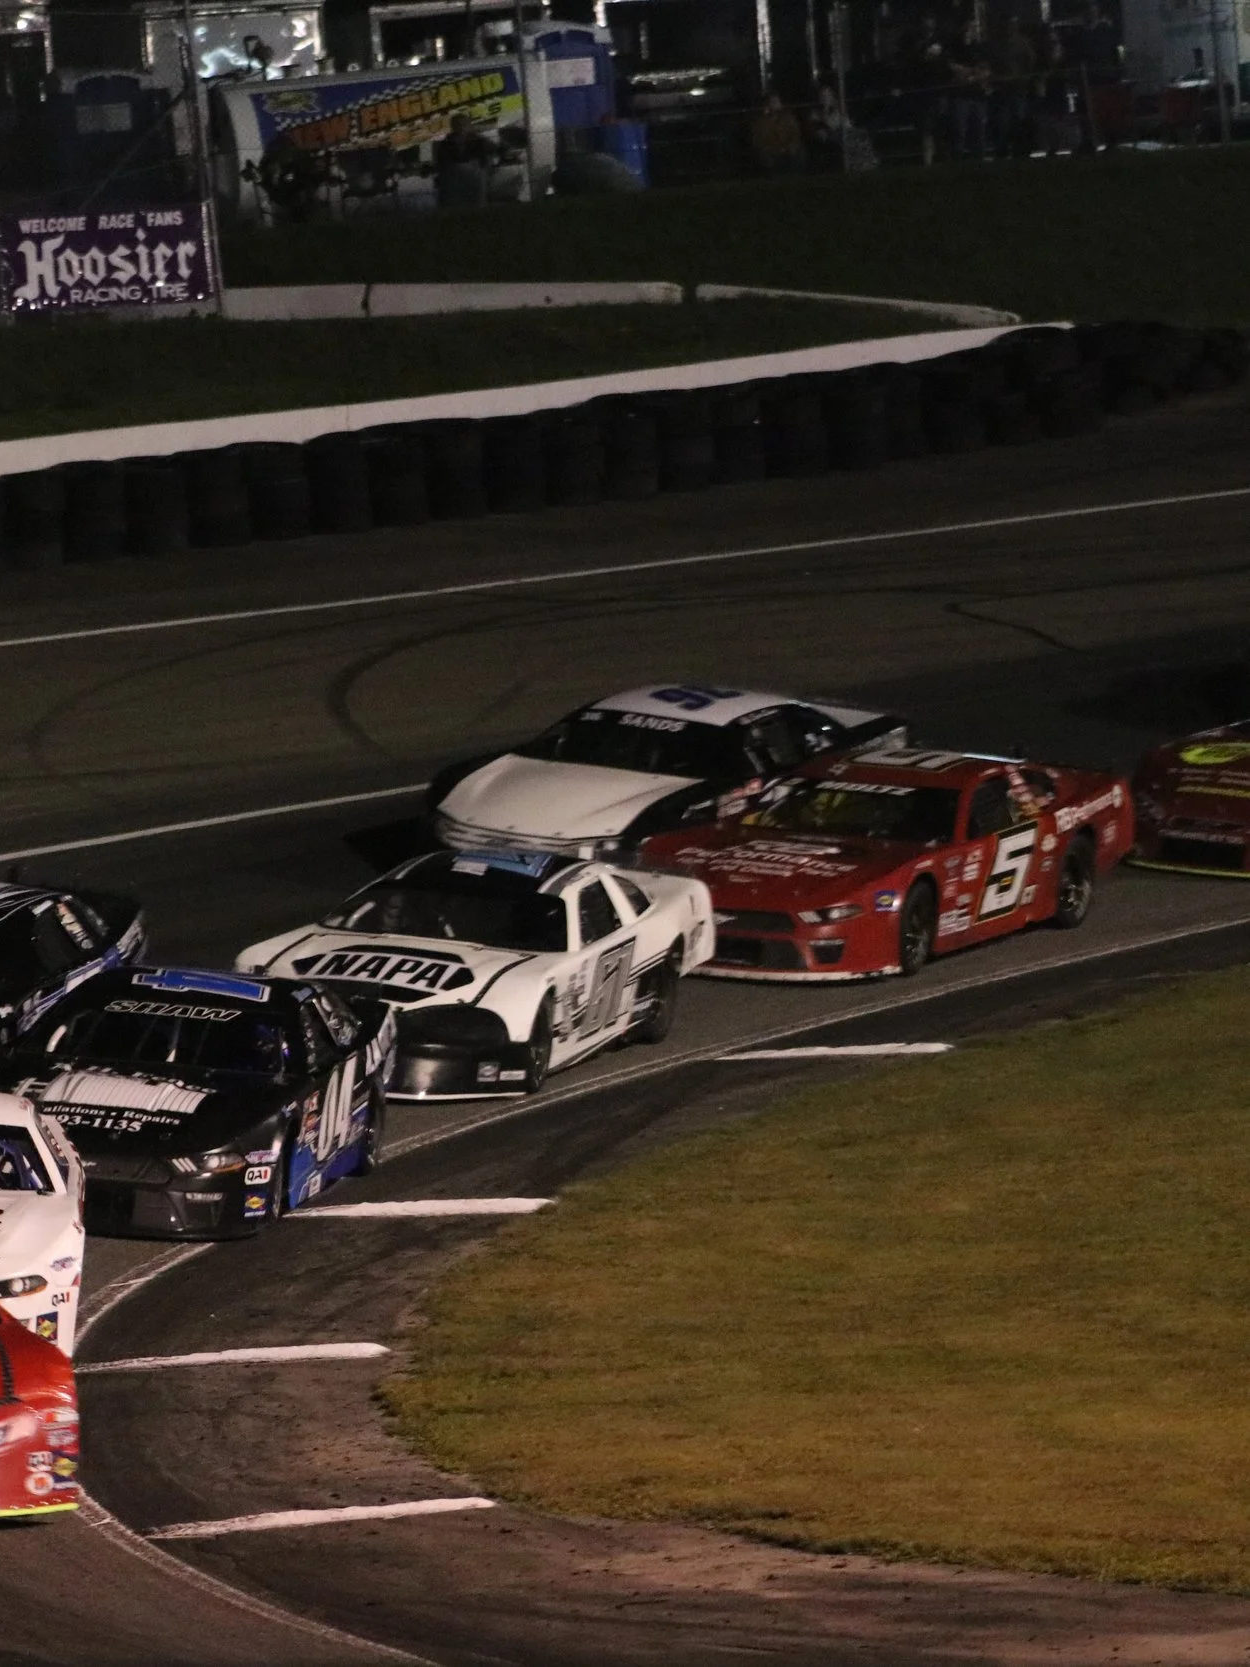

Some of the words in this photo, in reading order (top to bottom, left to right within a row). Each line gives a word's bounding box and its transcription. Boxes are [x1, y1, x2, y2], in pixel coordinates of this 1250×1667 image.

[358, 72, 506, 136] ENGLAND
[18, 216, 87, 234] WELCOME
[98, 213, 136, 230] RACE
[146, 210, 184, 227] FANS
[13, 228, 198, 300] Hoosier
[69, 285, 143, 303] RACING
[148, 282, 190, 299] TIRE
[617, 712, 688, 733] SANDS
[977, 828, 1035, 917] 5
[317, 954, 449, 988] NAPA
[104, 1000, 243, 1022] SHAW
[42, 1105, 105, 1117] allations
[122, 1110, 181, 1126] Repairs
[56, 1114, 144, 1133] 93-1135
